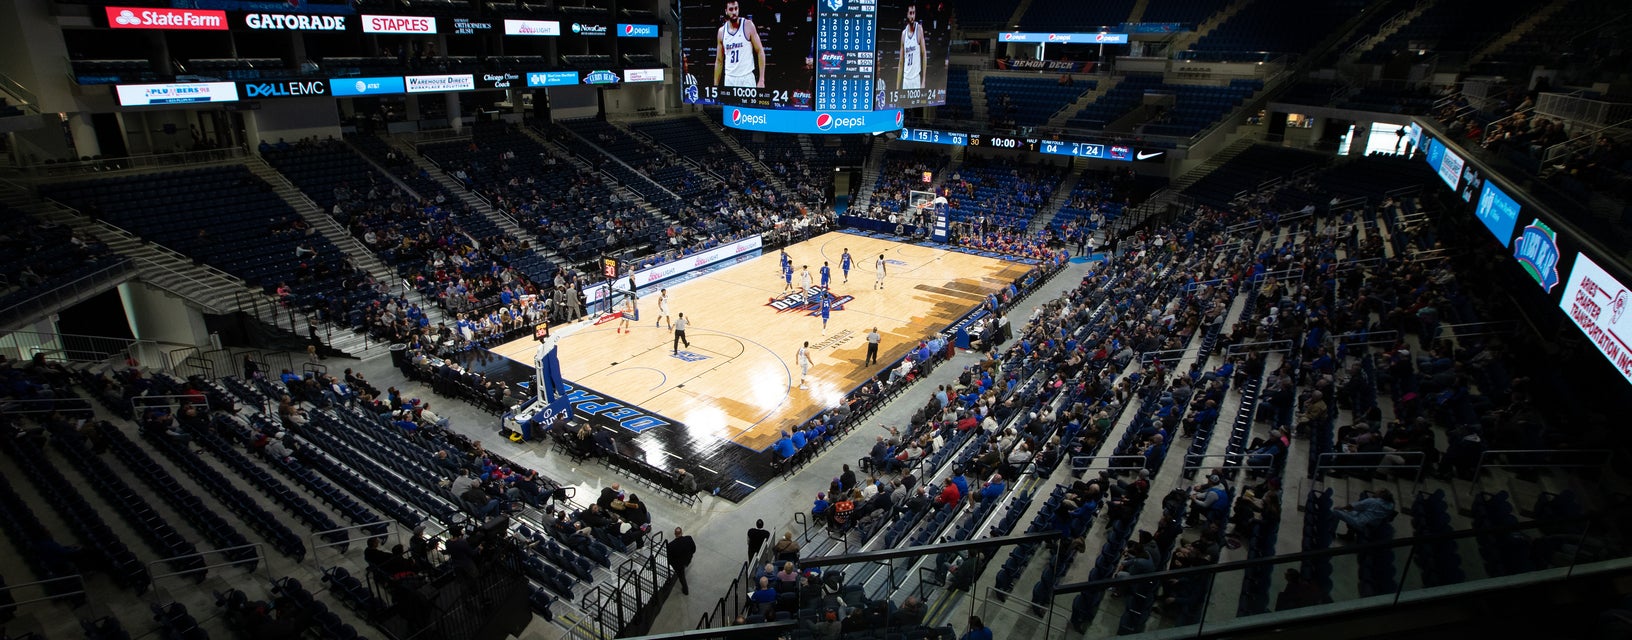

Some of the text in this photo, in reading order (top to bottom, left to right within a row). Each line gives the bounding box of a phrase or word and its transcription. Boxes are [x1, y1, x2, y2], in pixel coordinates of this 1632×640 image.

[246, 14, 346, 30] GATORADE
[372, 18, 428, 31] STAPLES
[731, 50, 739, 63] 31
[705, 86, 718, 98] 15
[733, 87, 757, 98] 10:00
[772, 90, 789, 102] 24
[890, 91, 898, 102] 15
[907, 90, 920, 99] 10:00
[928, 89, 936, 100] 24
[742, 114, 766, 124] pepsi
[835, 116, 865, 128] pepsi
[991, 138, 1015, 147] 10:00
[1086, 146, 1098, 155] 24
[605, 266, 615, 277] 30
[1581, 276, 1598, 298] ARIES
[1576, 289, 1601, 320] CHARTER
[1570, 303, 1620, 361] TRANSPORTATION
